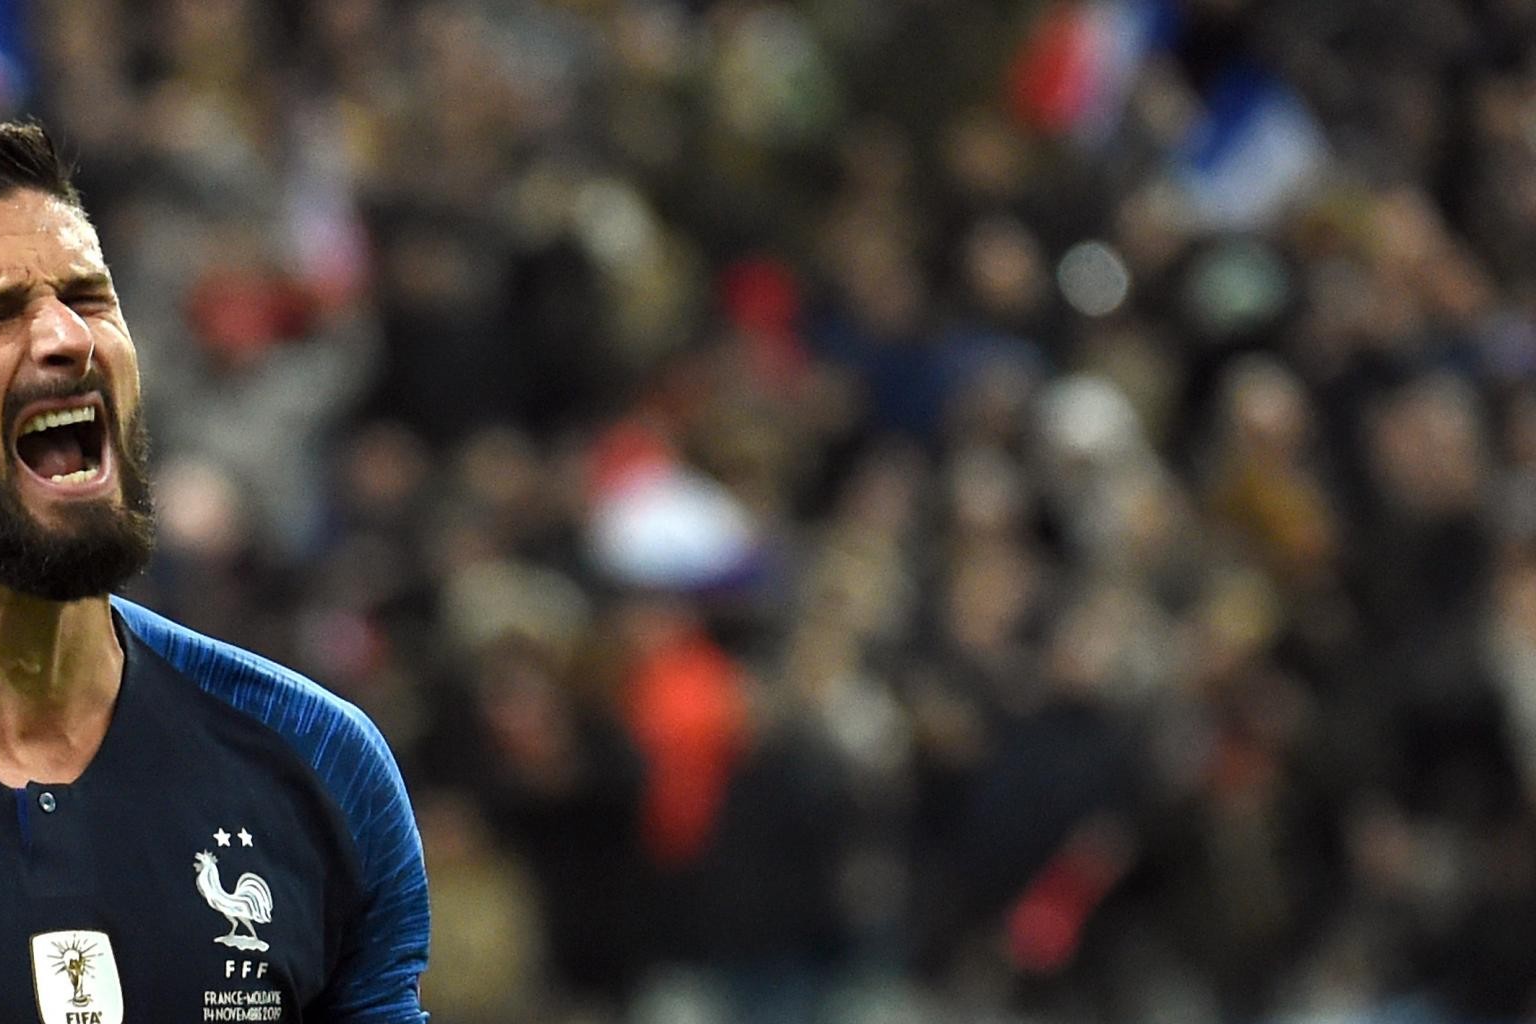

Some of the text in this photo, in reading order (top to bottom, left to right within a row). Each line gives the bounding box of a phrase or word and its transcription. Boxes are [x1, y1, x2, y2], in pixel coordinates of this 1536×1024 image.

[225, 960, 269, 979] FFF
[203, 1007, 215, 1022] 14
[263, 1006, 282, 1021] 2019
